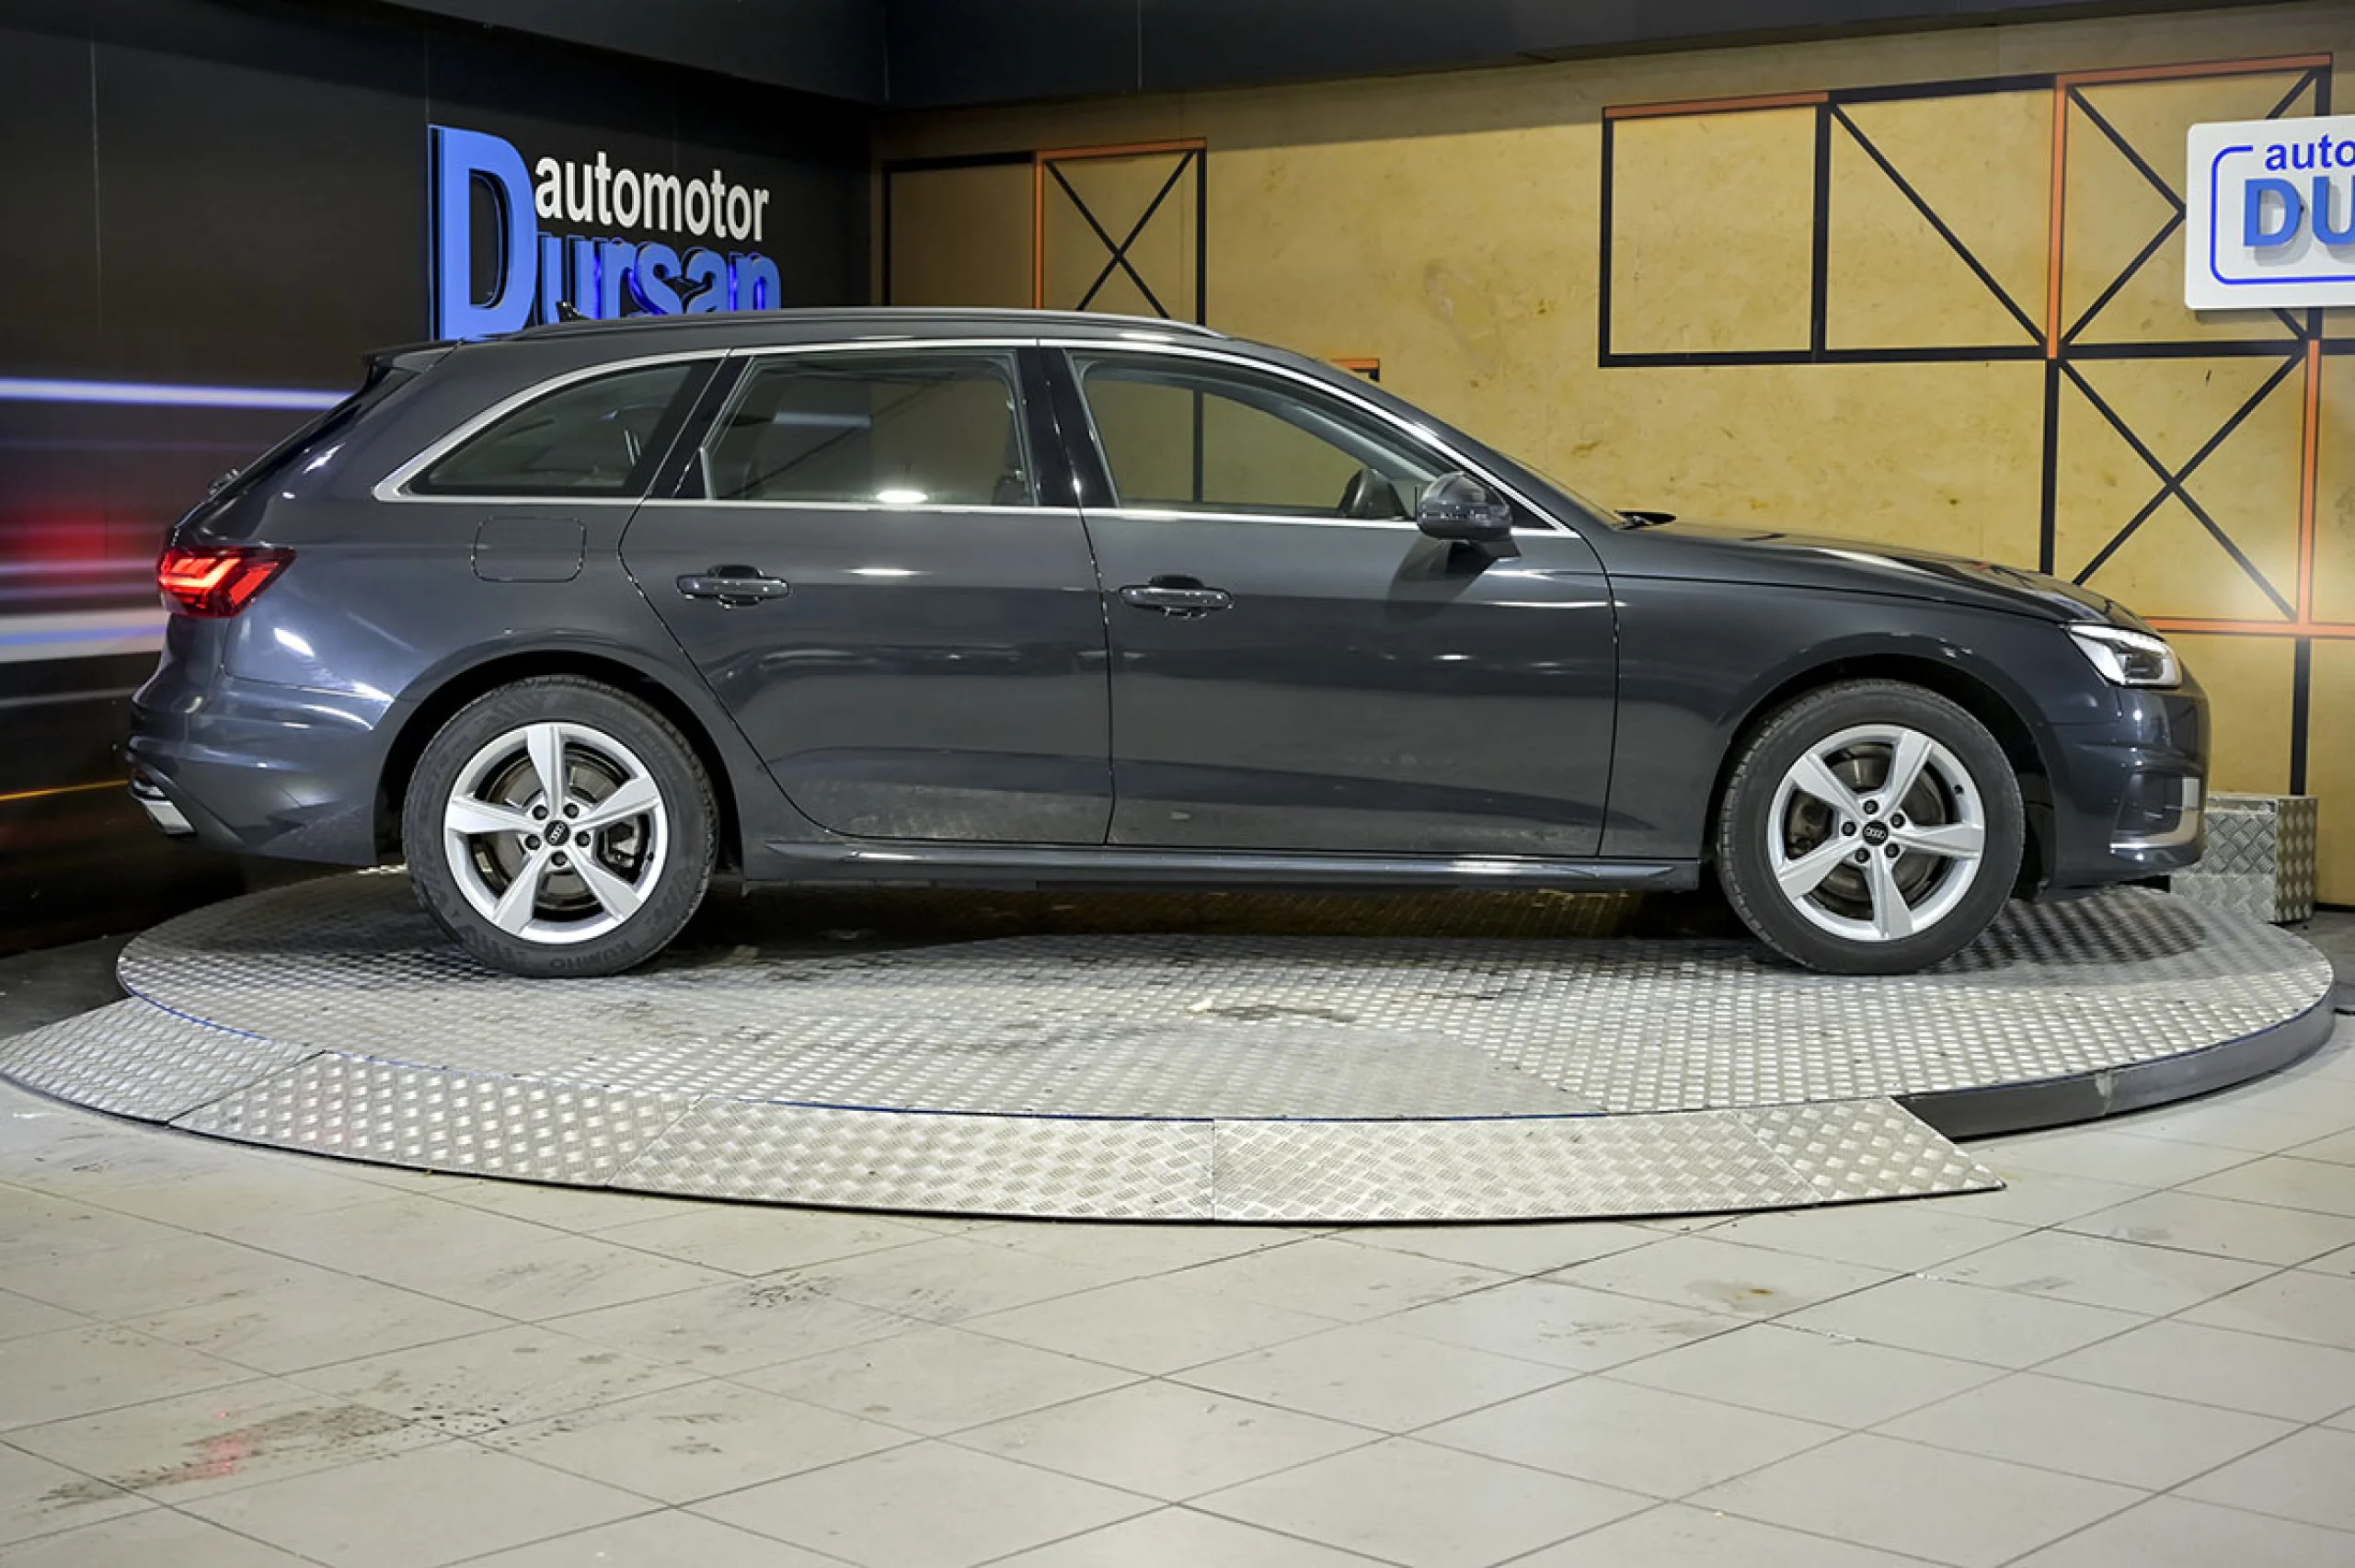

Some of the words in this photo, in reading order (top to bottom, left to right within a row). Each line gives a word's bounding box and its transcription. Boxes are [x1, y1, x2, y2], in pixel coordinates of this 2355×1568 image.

[534, 150, 770, 242] automotor
[2264, 133, 2355, 171] auto
[429, 124, 782, 342] Dursan
